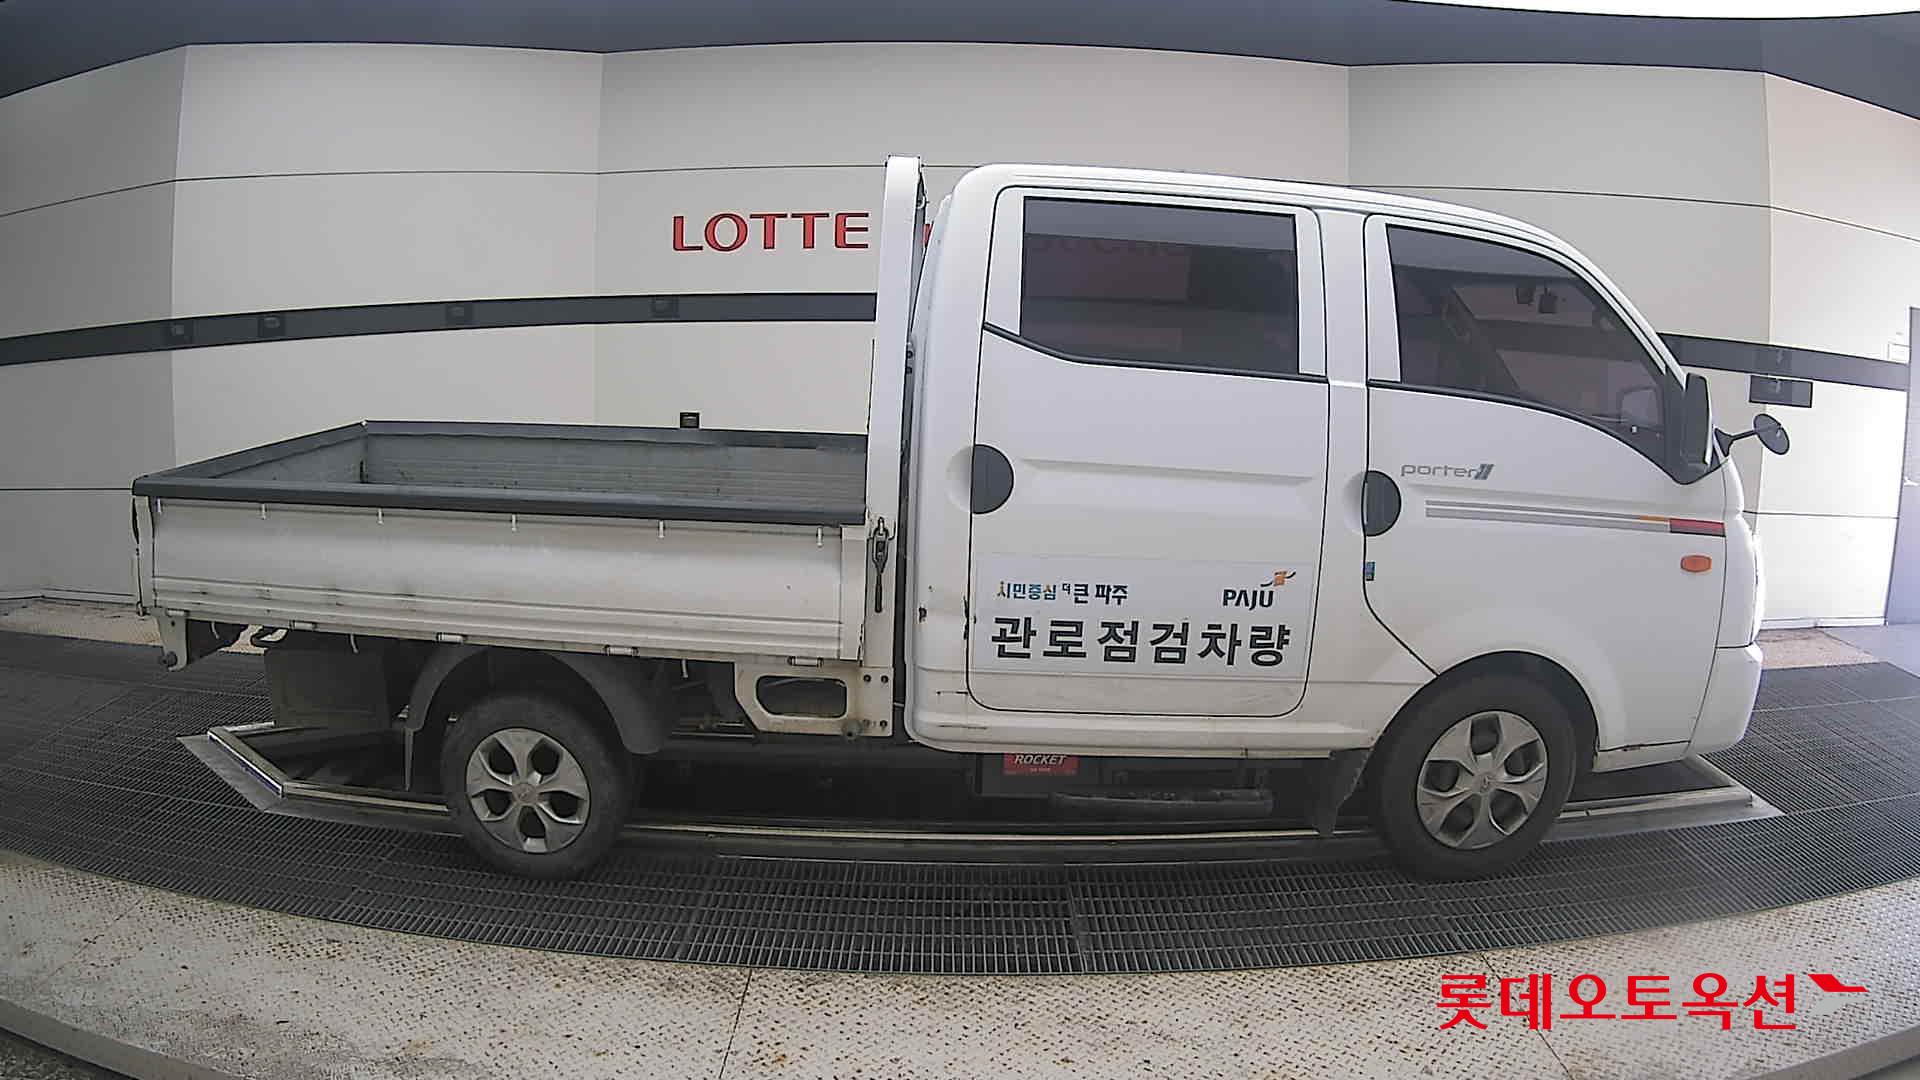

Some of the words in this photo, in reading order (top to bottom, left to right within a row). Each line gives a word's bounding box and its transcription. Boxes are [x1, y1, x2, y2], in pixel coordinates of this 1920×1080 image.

[673, 212, 869, 252] LOTTE
[997, 580, 1057, 600] 시민중심
[1095, 584, 1128, 605] 파주
[1223, 588, 1274, 610] PAJU
[1014, 754, 1066, 765] ROCKET
